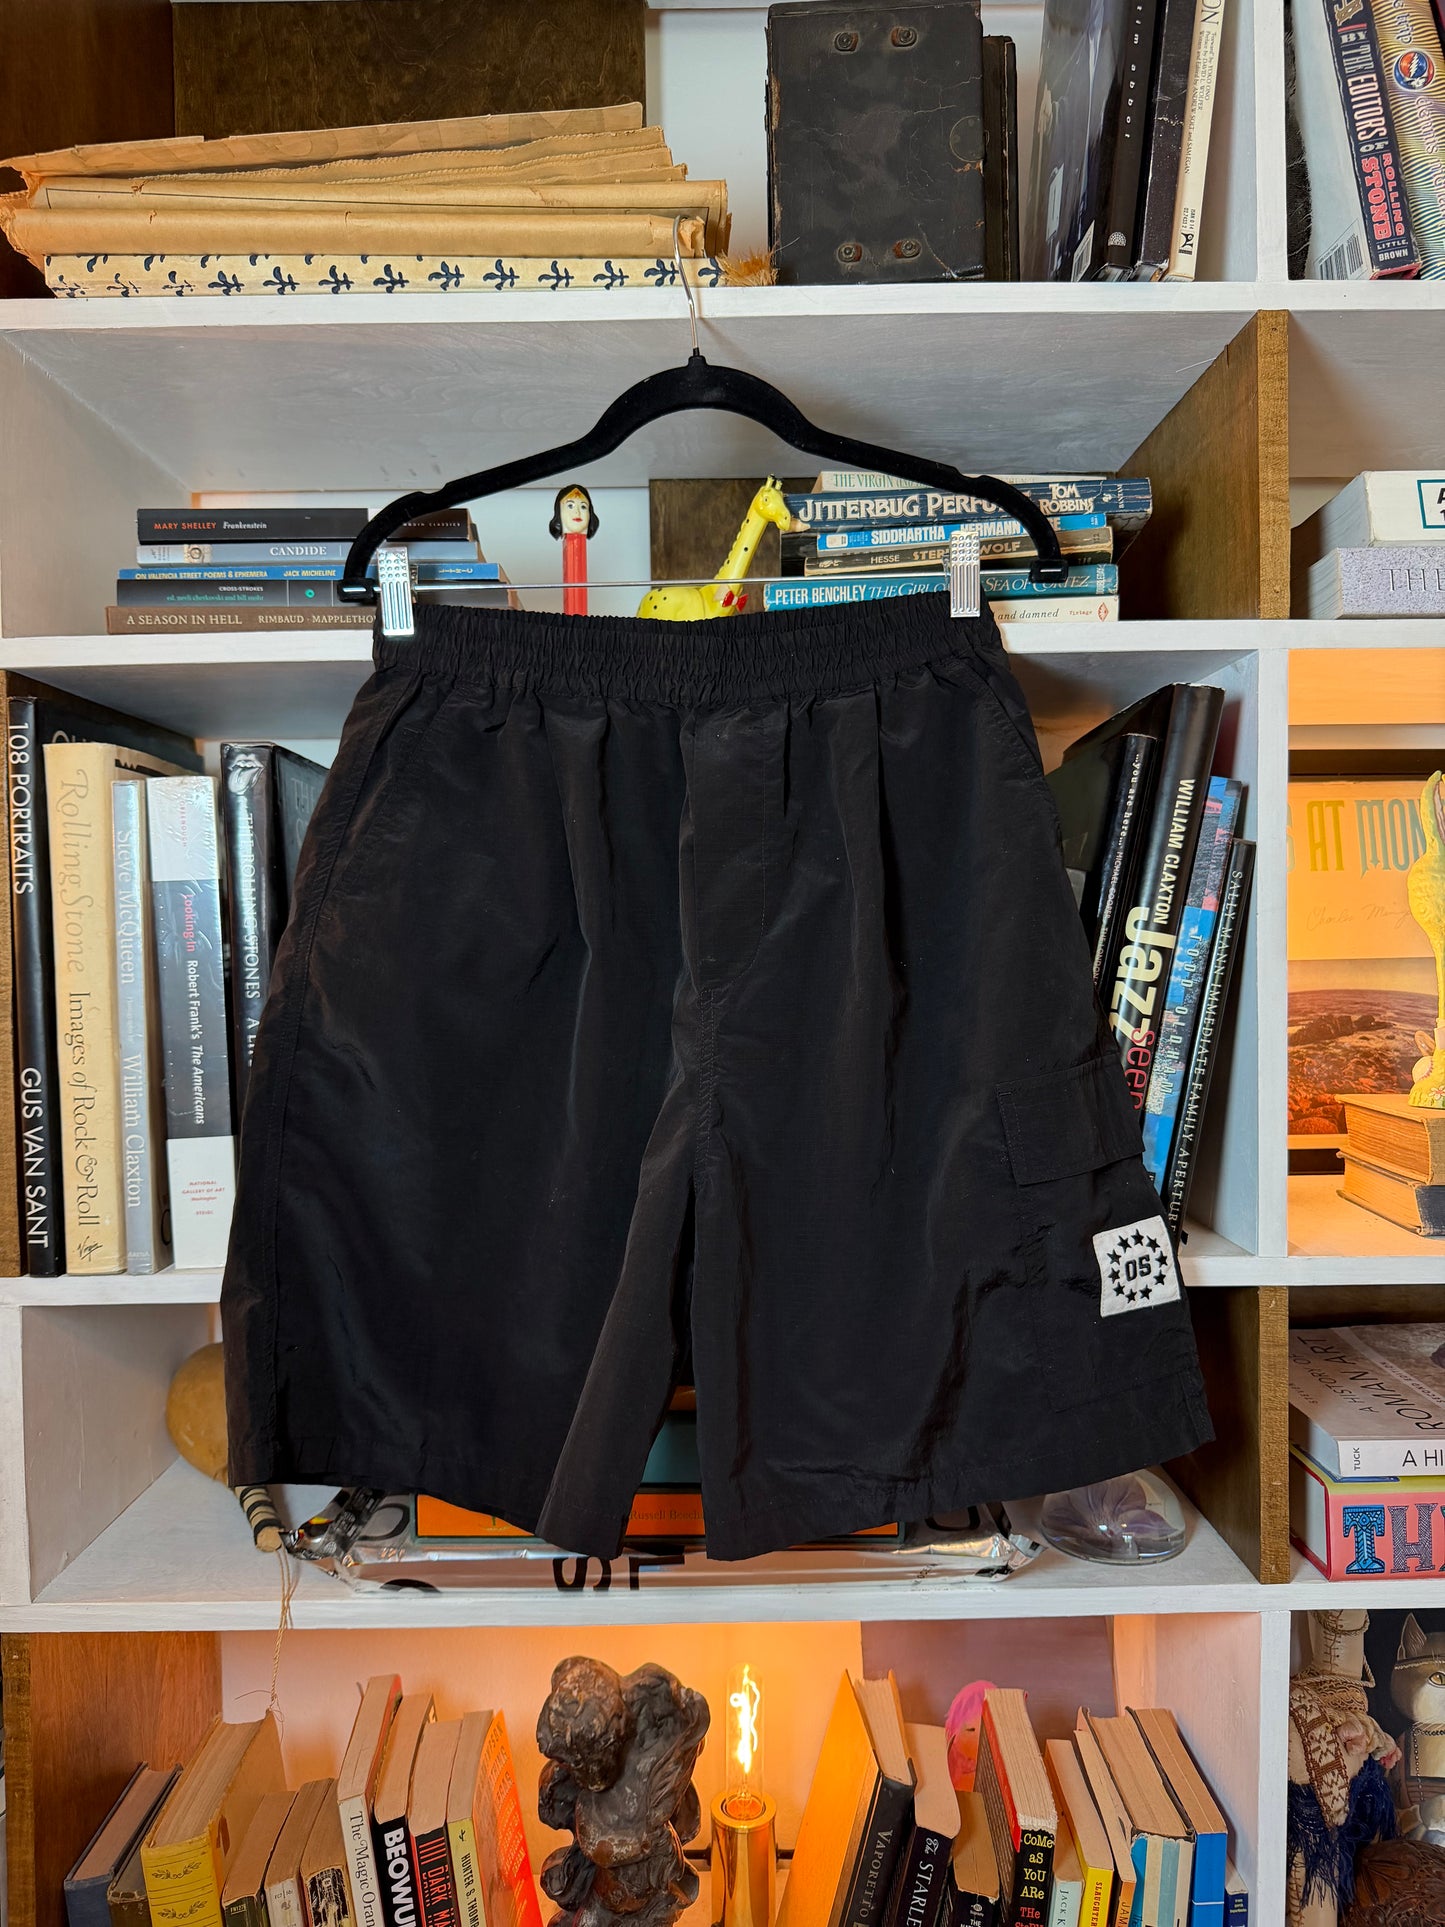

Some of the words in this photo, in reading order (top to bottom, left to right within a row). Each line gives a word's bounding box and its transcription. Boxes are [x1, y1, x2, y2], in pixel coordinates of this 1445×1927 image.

[1340, 31, 1368, 43] BY
[1396, 13, 1414, 44] trip
[1347, 73, 1388, 141] EDITORS
[1415, 96, 1439, 155] dennis
[1359, 141, 1389, 153] OF
[1361, 156, 1392, 240] STONE
[1382, 153, 1405, 237] ROLLING
[1376, 239, 1409, 250] LITTLE,
[1378, 248, 1409, 262] BROWN
[834, 473, 855, 488] THE
[857, 474, 893, 488] VIRGIN
[1048, 483, 1080, 500] TOM
[799, 494, 921, 522] JITTERBUG
[926, 492, 1005, 518] PERFU
[1038, 497, 1094, 516] ROBBINS
[153, 523, 179, 531] MARY
[181, 522, 217, 531] SHELLEY
[222, 521, 268, 530] Frankenstein
[871, 525, 946, 545] SIDDHARTHA
[269, 546, 328, 556] CANDIDE
[870, 554, 900, 564] HESSE
[148, 572, 177, 580] VALENCIA
[180, 571, 202, 579] STREET
[203, 570, 226, 578] POEMS
[234, 570, 268, 578] EPHEMERA
[283, 569, 300, 577] JACK
[301, 569, 336, 577] MICHELINE
[775, 587, 808, 605] PETER
[812, 584, 867, 604] BENCHLEY
[868, 585, 897, 599] THE
[898, 582, 930, 597] GIRL
[984, 577, 1011, 592] SEA
[127, 614, 136, 625] A
[138, 615, 188, 625] SEASON
[192, 614, 206, 625] IN
[209, 614, 242, 625] HELL
[258, 614, 304, 624] RIMBAUD
[312, 614, 376, 624] MAPPLETHO
[997, 610, 1017, 621] and
[1019, 608, 1060, 619] damned
[9, 722, 30, 765] 108
[1126, 788, 1135, 807] are
[1165, 779, 1196, 849] WILLIAM
[9, 774, 34, 895] PORTRAITS
[55, 768, 93, 886] Rolling
[180, 800, 188, 847] GREENOUGH
[241, 813, 254, 848] THE
[1306, 800, 1345, 871] AT
[1354, 798, 1428, 880] MON
[116, 831, 130, 882] Steve
[1111, 851, 1124, 884] MICHAEL
[241, 851, 258, 930] ROLLING
[1104, 888, 1117, 918] COOPER
[1152, 852, 1180, 925] CLAXTON
[1223, 870, 1243, 920] SALLY
[59, 889, 94, 973] Stone
[183, 893, 197, 939] Looking
[117, 889, 136, 984] McQueen
[186, 940, 198, 952] In
[1213, 927, 1233, 976] MANN
[186, 960, 200, 998] Robert
[243, 931, 261, 999] STONES
[1107, 906, 1177, 1048] Jazz
[1180, 934, 1203, 988] TODD
[64, 991, 91, 1065] Images
[188, 1000, 203, 1040] Frank's
[246, 1018, 260, 1030] A
[1197, 983, 1222, 1076] IMMEDIATE
[191, 1045, 204, 1065] The
[1160, 1005, 1188, 1094] OLDHAM
[20, 1067, 44, 1119] GUS
[67, 1071, 98, 1093] of
[122, 1053, 142, 1128] William
[192, 1067, 206, 1125] Americans
[73, 1096, 97, 1150] Rock
[1182, 1081, 1203, 1142] FAMILY
[23, 1125, 46, 1177] VAN
[75, 1153, 98, 1183] &
[124, 1134, 145, 1208] Claxton
[25, 1185, 49, 1248] SANT
[77, 1184, 100, 1226] Roll
[1296, 1335, 1356, 1365] ART
[1305, 1367, 1365, 1404] HISTORY
[1341, 1370, 1445, 1430] ROMAN
[1358, 1406, 1379, 1414] A
[1353, 1446, 1361, 1471] TUCK
[1402, 1450, 1418, 1467] A
[631, 1510, 666, 1520] Russell
[1343, 1502, 1445, 1574] TH
[349, 1811, 364, 1841] The
[924, 1837, 939, 1855] The
[1029, 1852, 1044, 1864] aS
[354, 1840, 373, 1890] Magic
[461, 1852, 474, 1889] HUNTER
[427, 1865, 448, 1905] DARK
[466, 1888, 475, 1900] S.
[1020, 1885, 1045, 1900] ARe
[1059, 1889, 1069, 1914] JACK
[1019, 1907, 1041, 1919] THe
